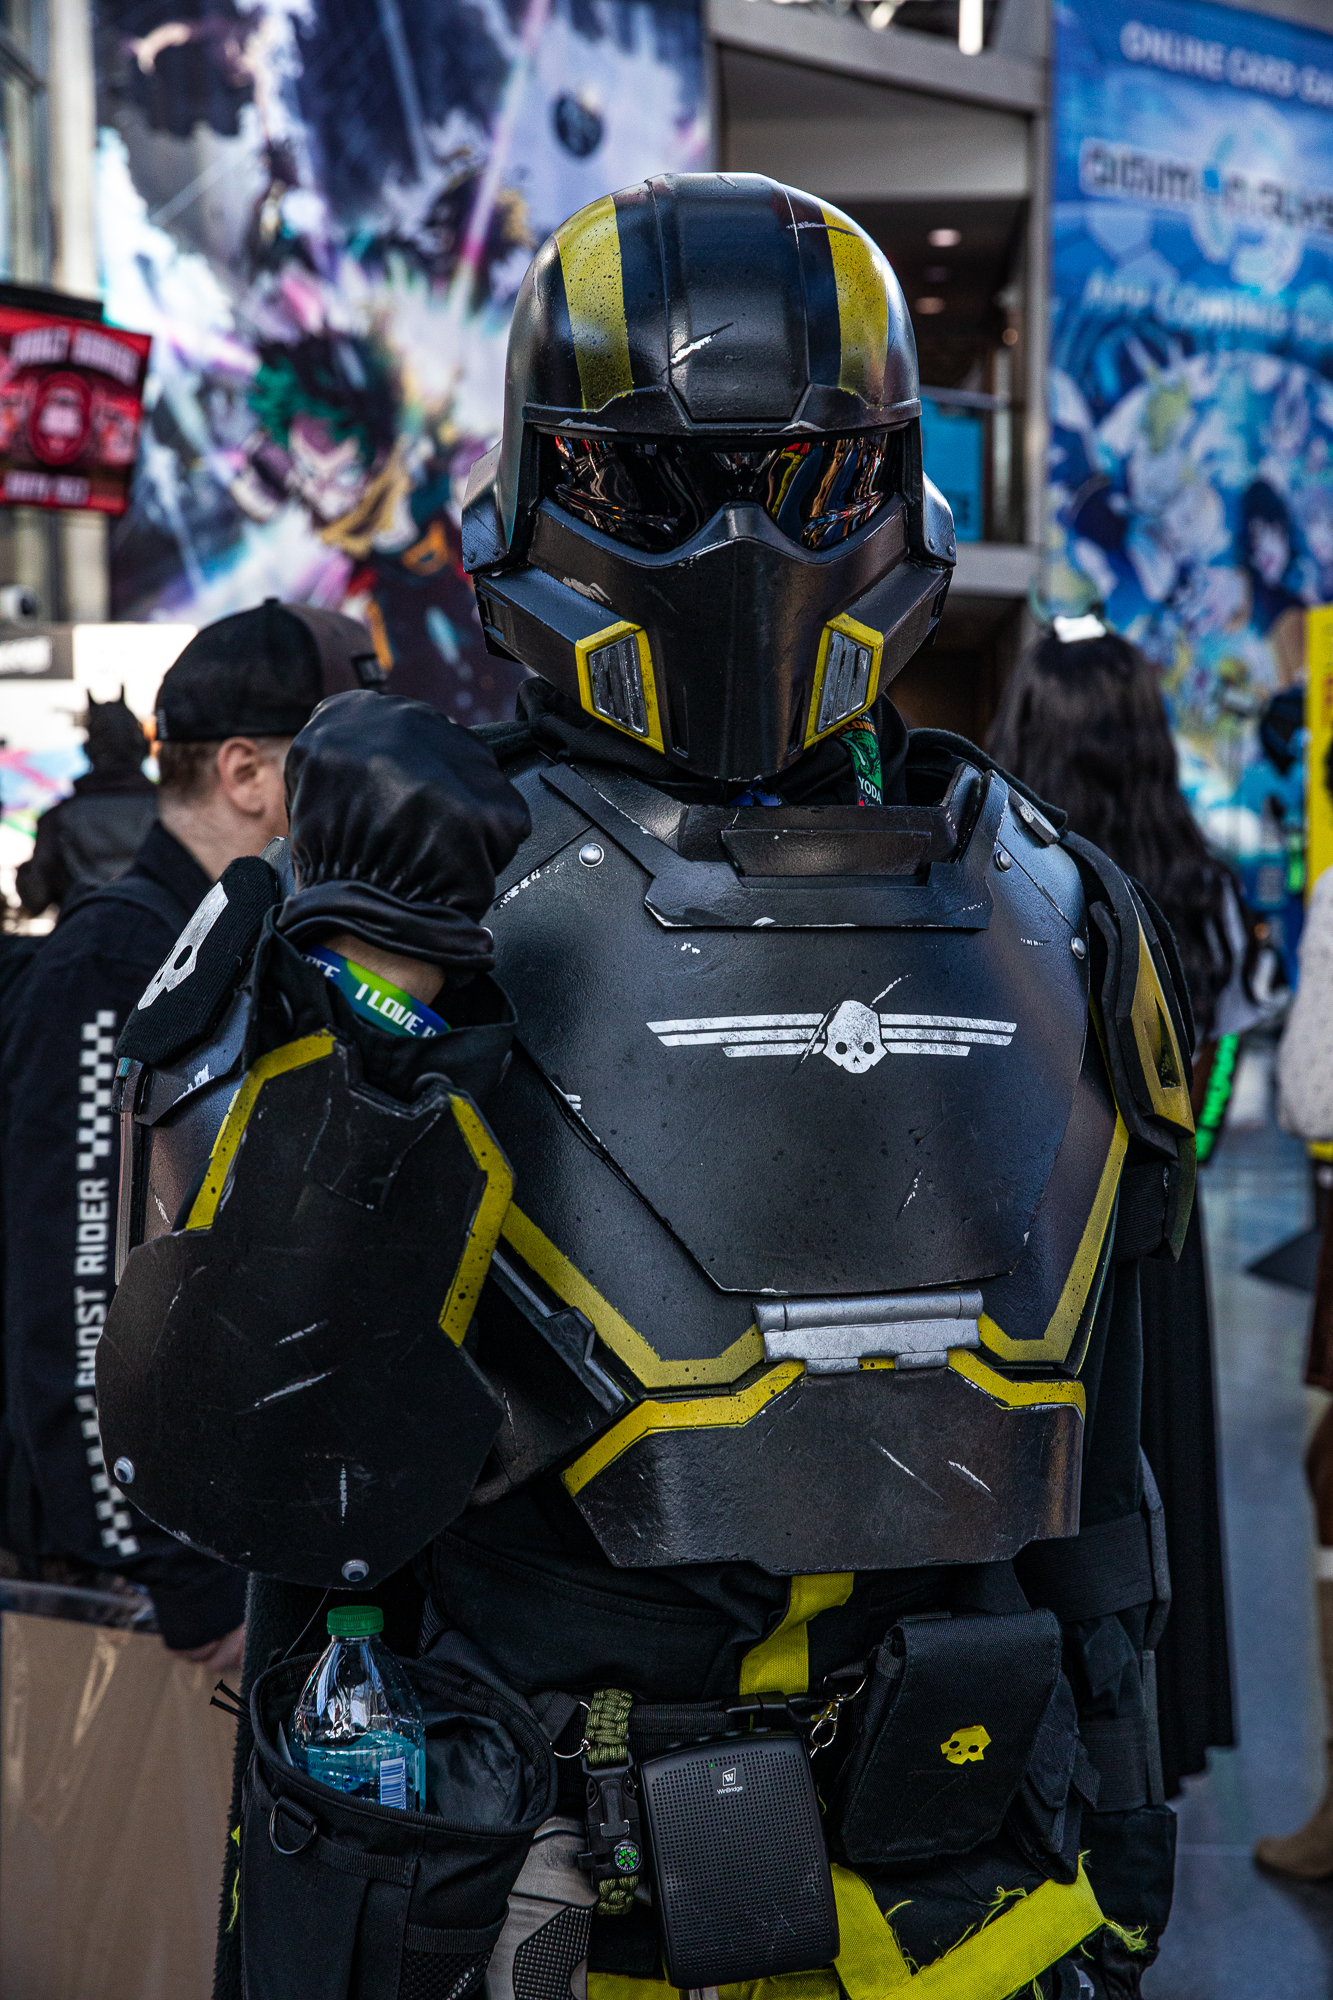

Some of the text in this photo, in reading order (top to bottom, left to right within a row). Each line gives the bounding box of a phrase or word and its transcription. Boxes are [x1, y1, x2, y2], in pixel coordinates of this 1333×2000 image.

[1120, 20, 1226, 82] ONLINE
[857, 775, 882, 805] YODA
[355, 983, 369, 1000] I
[367, 989, 424, 1035] LOVE
[75, 1178, 109, 1387] GHOST RIDER
[717, 1786, 743, 1794] WinBridge
